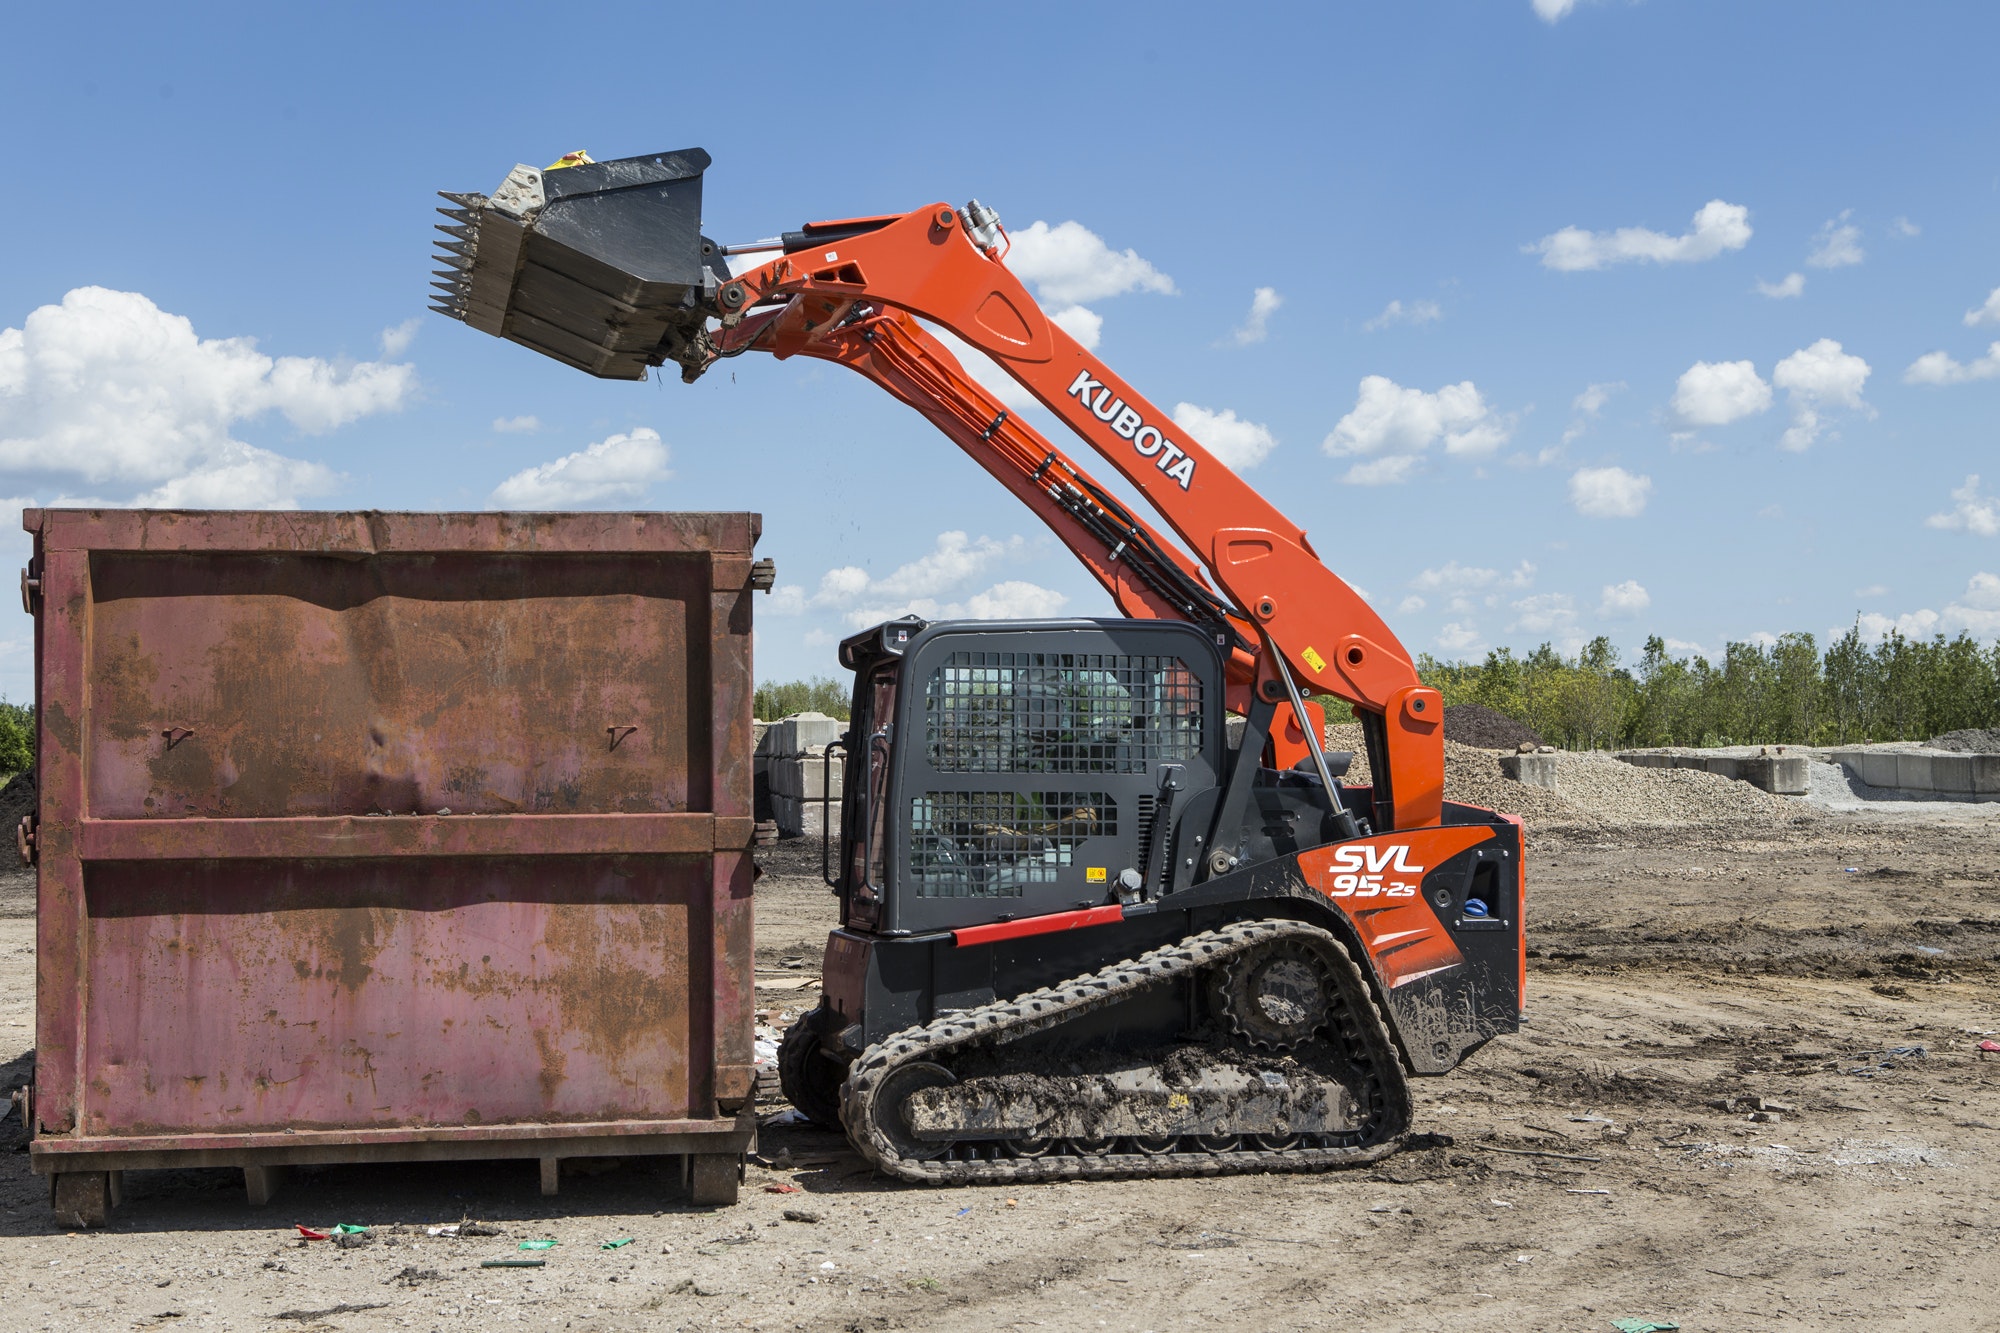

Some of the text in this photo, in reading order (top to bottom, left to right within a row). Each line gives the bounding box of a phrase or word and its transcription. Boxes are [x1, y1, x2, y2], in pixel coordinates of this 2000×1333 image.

[1067, 369, 1196, 491] KUBOTA
[1328, 845, 1425, 873] SVL
[1330, 874, 1417, 897] 95-2s
